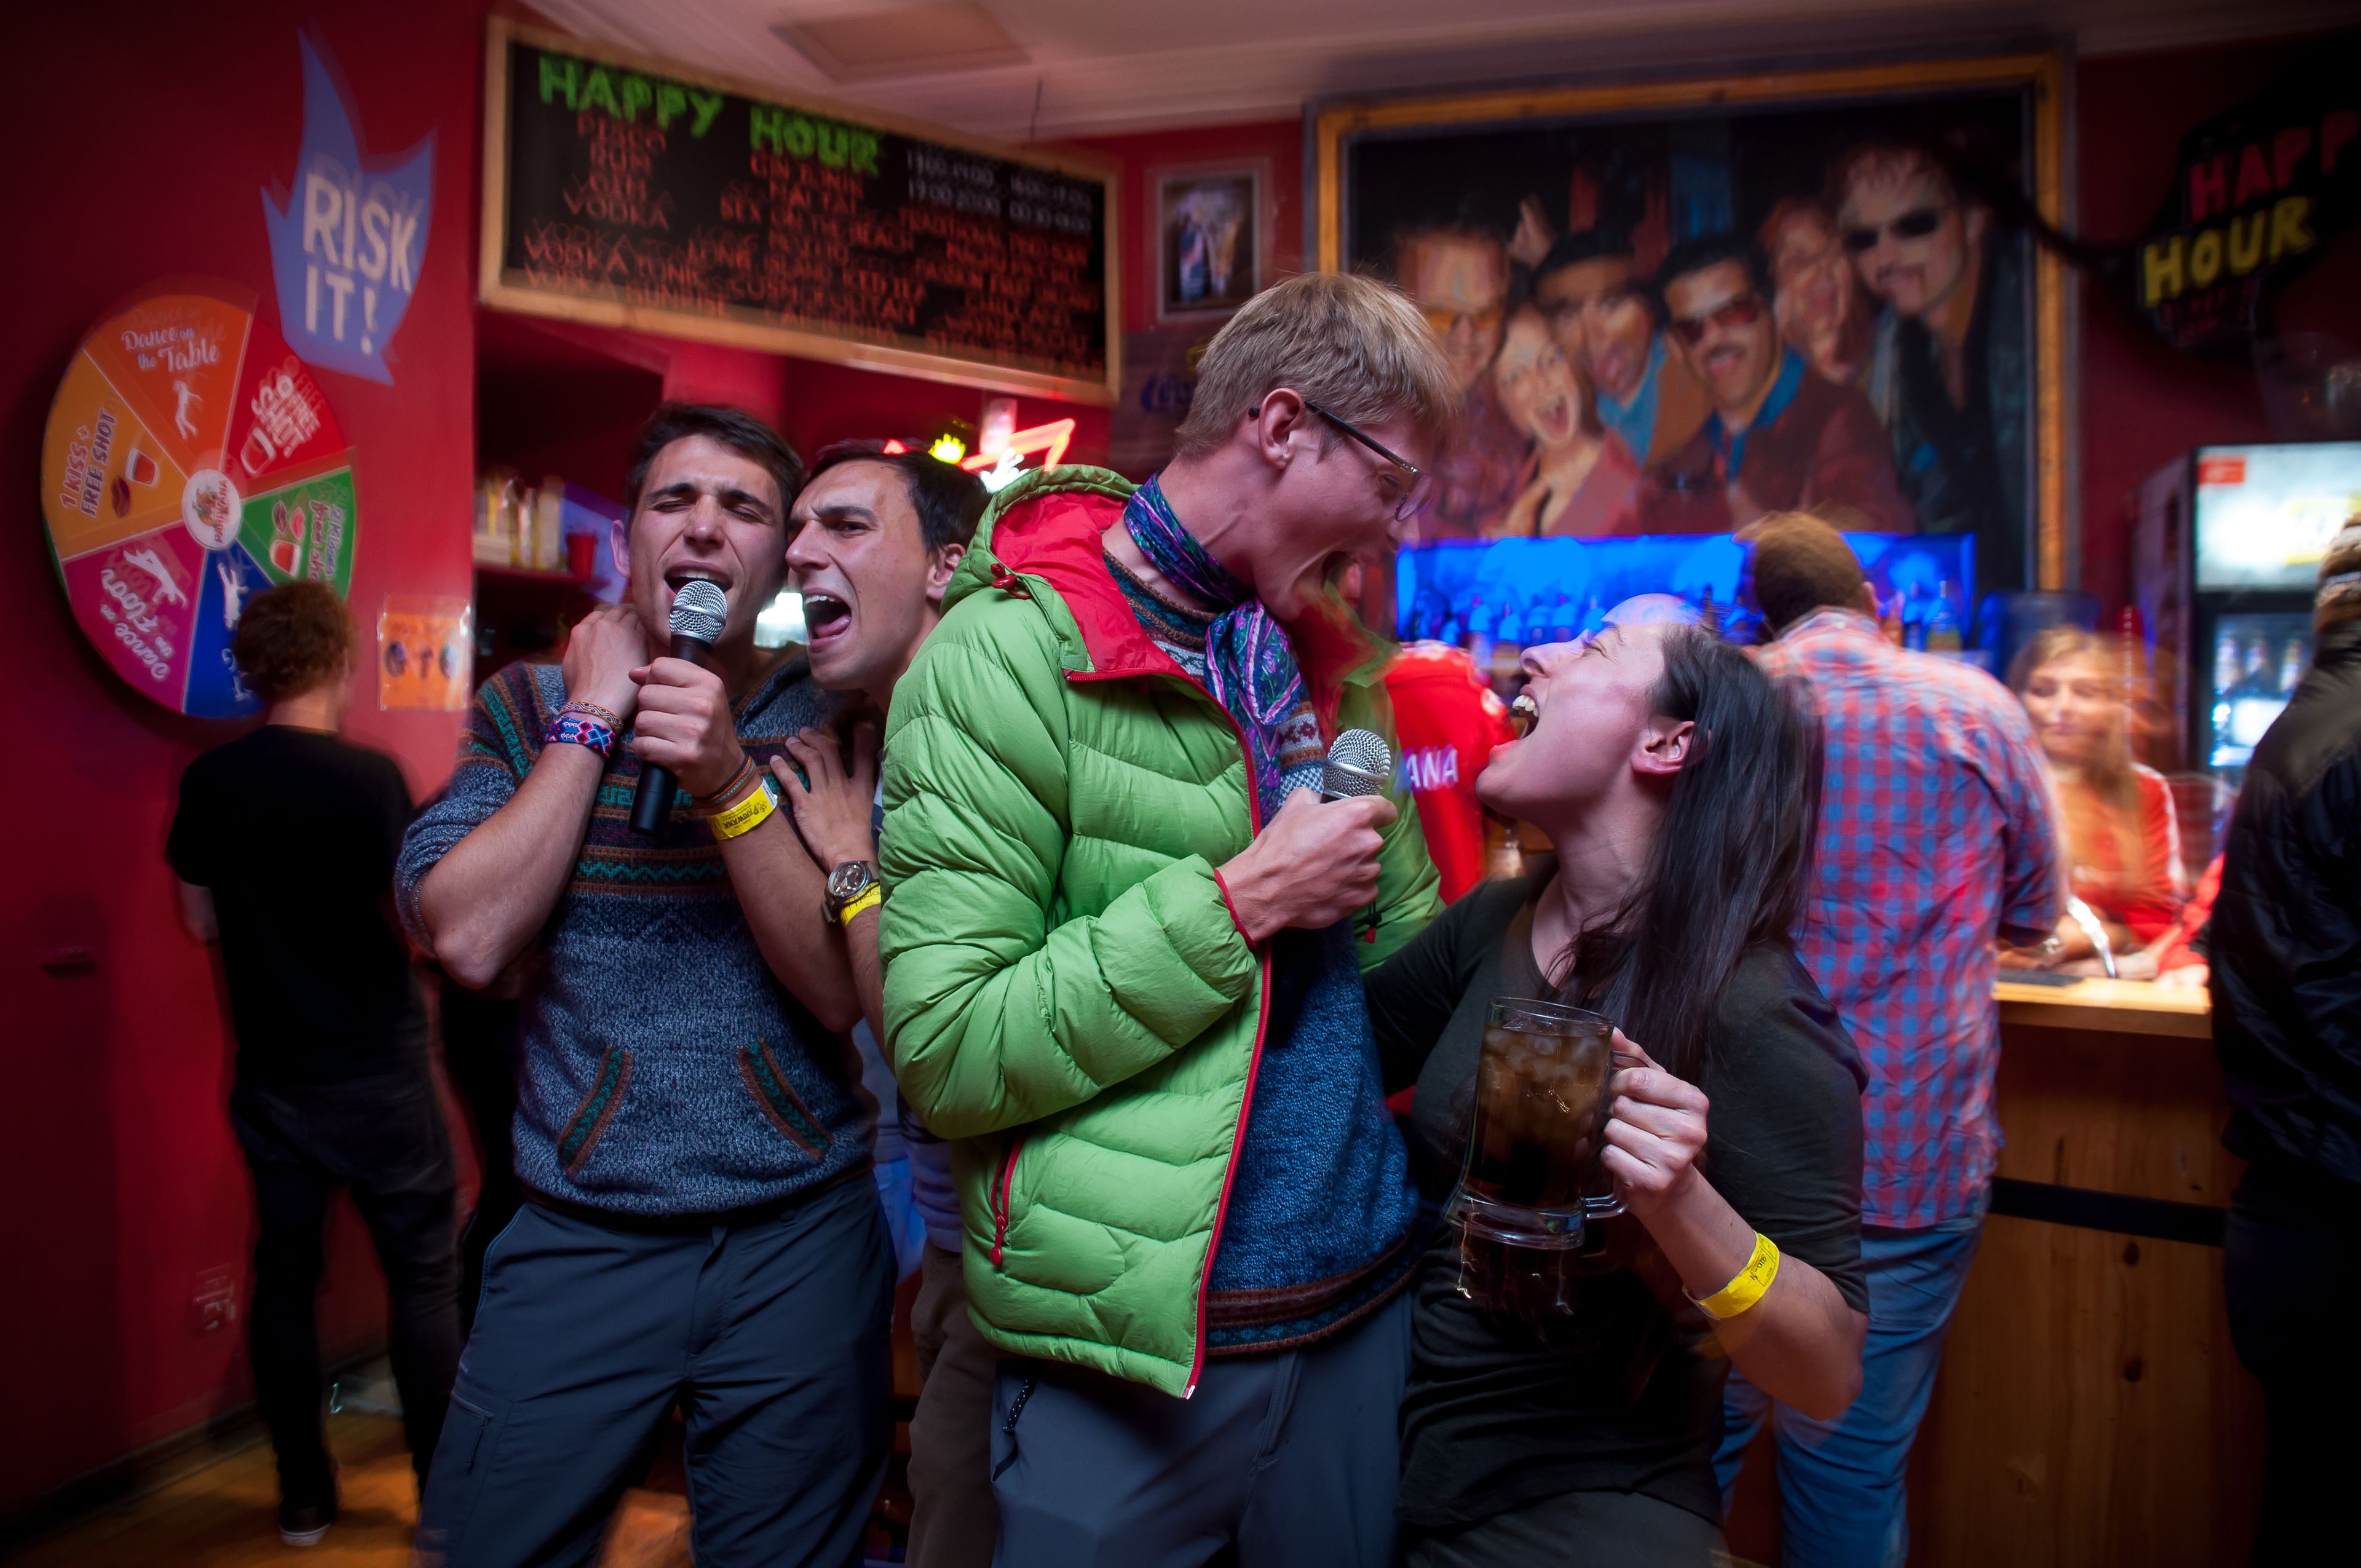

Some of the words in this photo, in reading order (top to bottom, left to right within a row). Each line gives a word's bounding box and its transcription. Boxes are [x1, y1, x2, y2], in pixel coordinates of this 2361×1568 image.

[539, 53, 724, 138] HAPPY
[749, 103, 880, 176] HOUR
[303, 171, 417, 295] RISK
[2143, 196, 2312, 307] HOUR
[121, 327, 177, 350] Dance
[306, 264, 377, 356] IT!
[157, 338, 220, 373] Table
[92, 407, 117, 465] SHOT
[251, 385, 306, 459] SHOT
[63, 442, 87, 493] KISS
[81, 465, 104, 518] FREE
[101, 569, 158, 633] Floor
[114, 628, 168, 679] Dance
